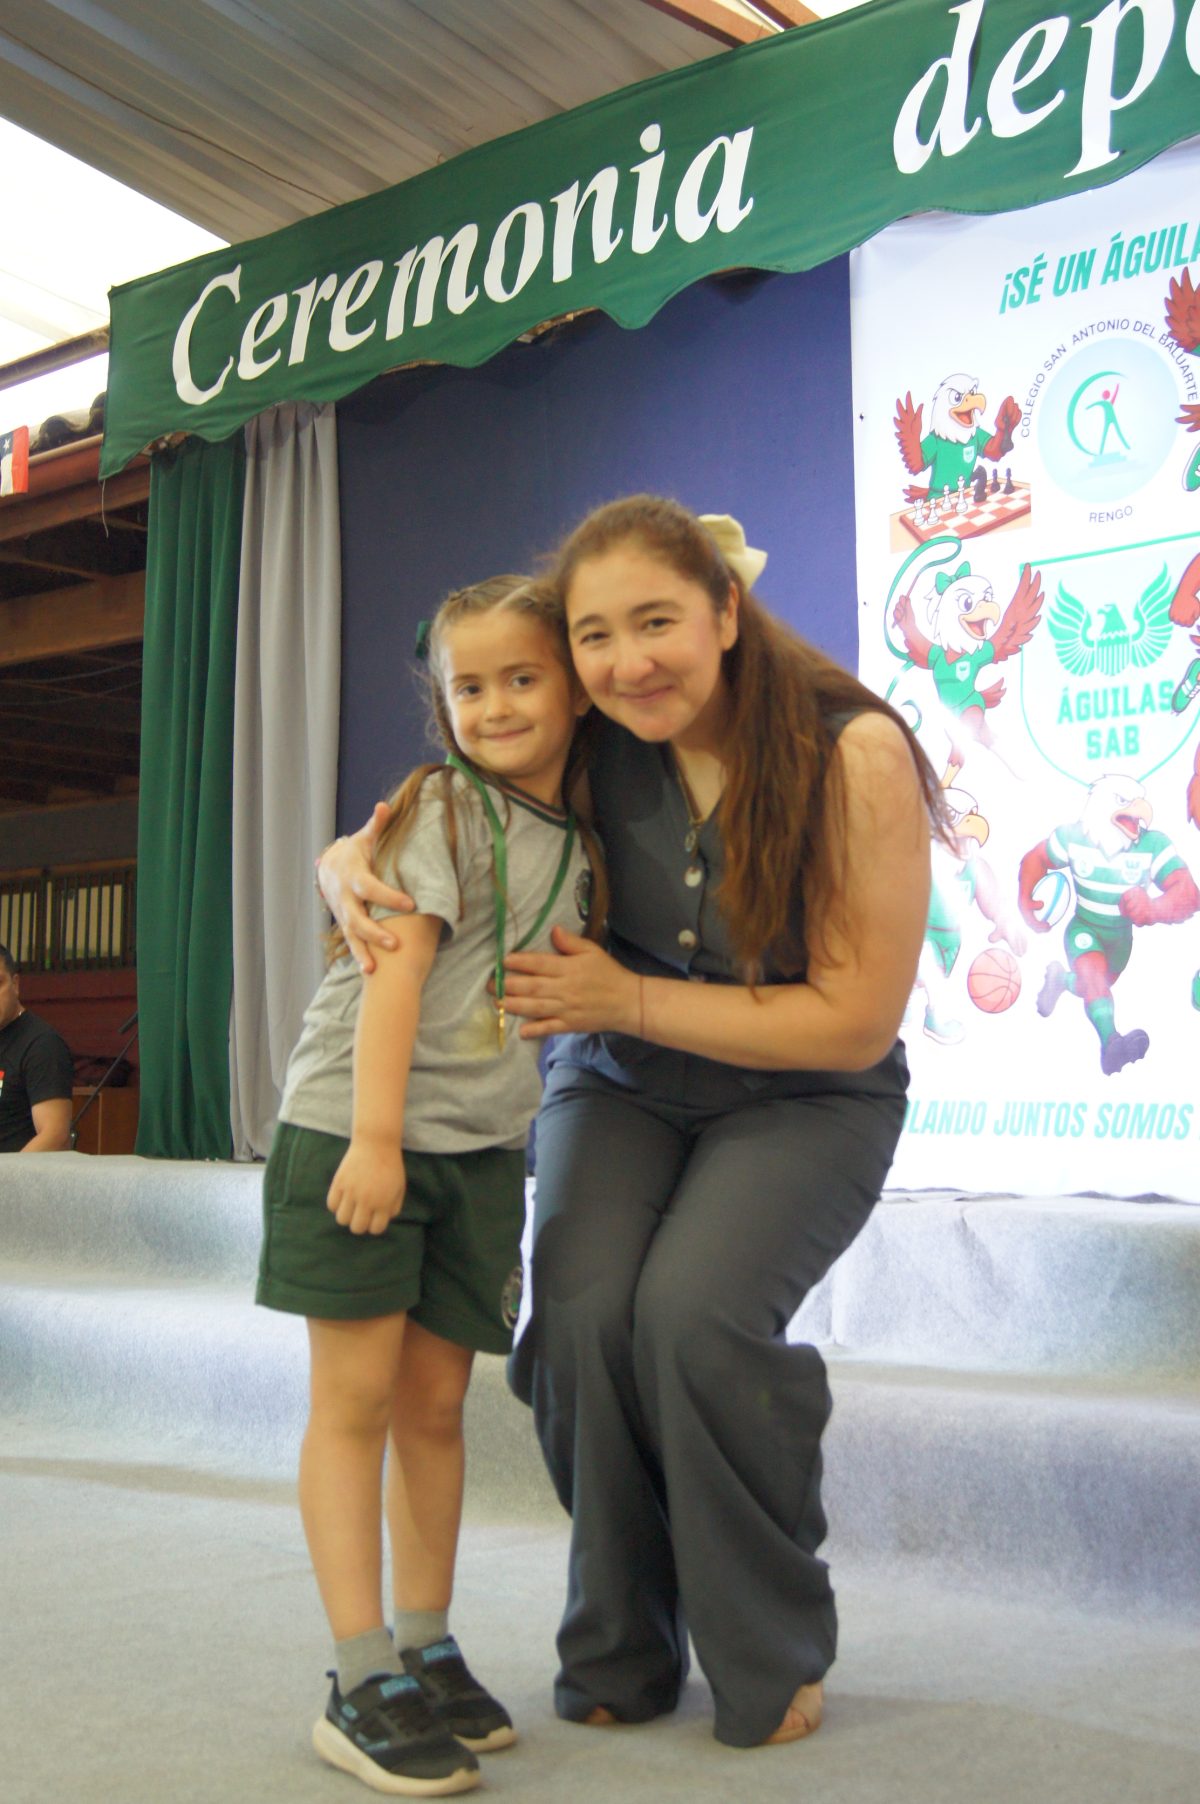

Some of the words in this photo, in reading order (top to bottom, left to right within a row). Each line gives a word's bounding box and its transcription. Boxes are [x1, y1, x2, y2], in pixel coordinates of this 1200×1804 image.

[171, 123, 755, 406] Ceremonia
[893, 0, 1200, 178] dep
[999, 252, 1047, 315] ¡SÉ
[1053, 247, 1097, 297] UN
[1020, 373, 1046, 438] COLEGIO
[1043, 344, 1067, 371] SAN
[1072, 318, 1130, 345] ANTONIO
[1133, 320, 1156, 340] DEL
[1158, 333, 1198, 402] BALUARTE
[1088, 505, 1134, 523] RENGO
[1056, 680, 1176, 726] ÁGUILAS
[1086, 725, 1140, 760] SAB
[993, 1101, 1088, 1138] JUNTOS
[1094, 1102, 1194, 1140] SOMOS
